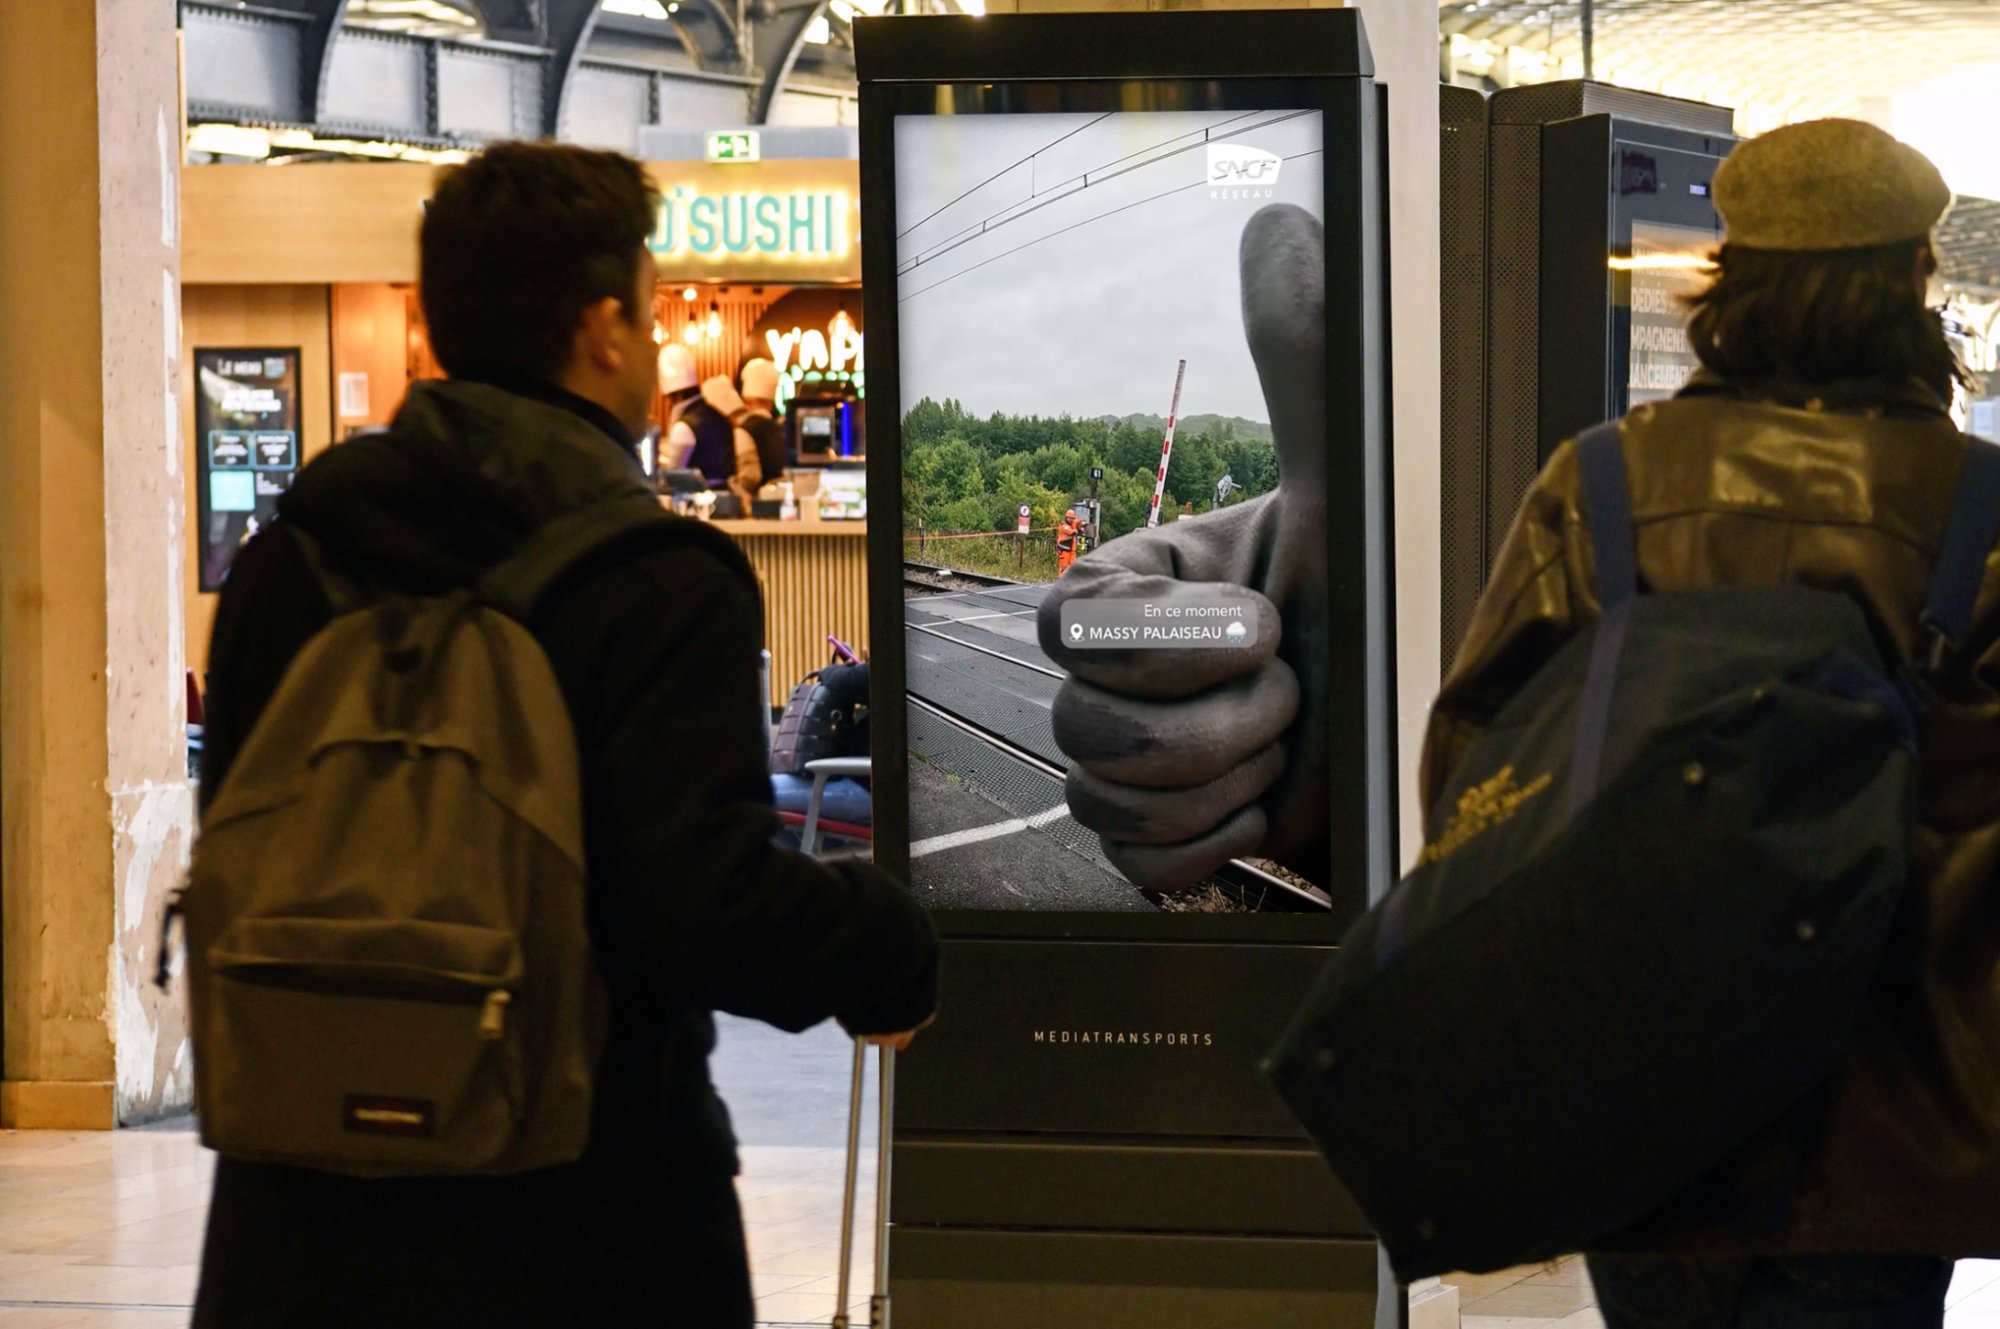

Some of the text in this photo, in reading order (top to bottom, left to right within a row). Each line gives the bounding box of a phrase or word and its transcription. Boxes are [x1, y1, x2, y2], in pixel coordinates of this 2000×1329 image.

[1212, 160, 1276, 179] SNCF
[1144, 604, 1242, 617] En ce moment
[1089, 627, 1222, 640] MASSY PALAISEAU
[1034, 1031, 1212, 1046] MEDIATRANSPORTS
